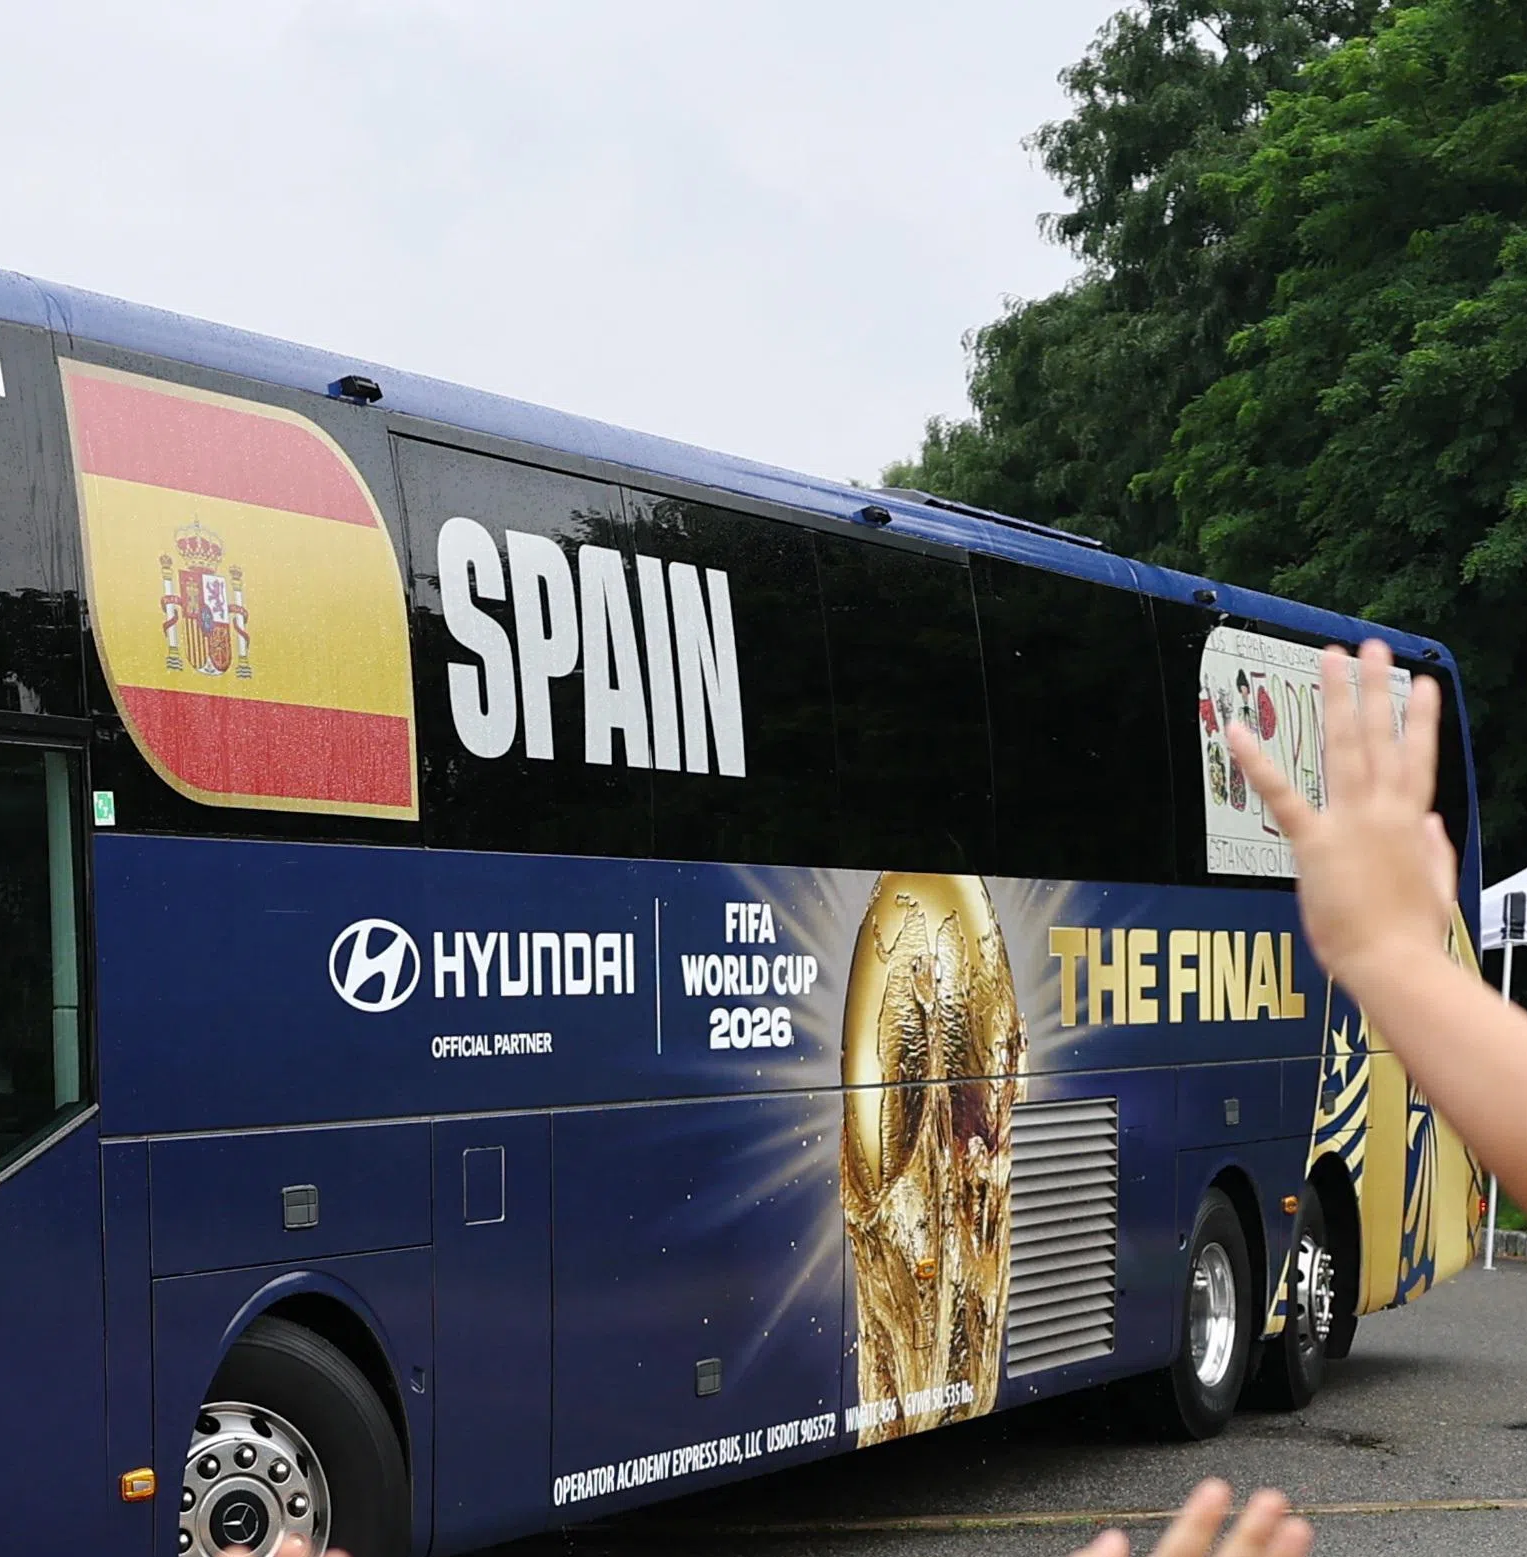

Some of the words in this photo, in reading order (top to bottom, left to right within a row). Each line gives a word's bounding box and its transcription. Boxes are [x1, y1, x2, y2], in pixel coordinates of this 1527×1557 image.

[437, 516, 746, 777] SPAIN
[725, 902, 776, 944] FIFA
[433, 932, 635, 998] HYUNDAI
[681, 955, 769, 997] WORLD
[772, 955, 818, 995] CUP
[1048, 926, 1159, 1027] THE
[1169, 930, 1305, 1024] FINAL
[431, 1033, 492, 1059] OFFICIAL
[494, 1032, 553, 1056] PARTNER
[709, 1006, 794, 1050] 2026
[553, 1465, 615, 1506] OPERATOR
[616, 1451, 671, 1491] ACADEMY
[672, 1440, 718, 1477] EXPRESS
[719, 1435, 743, 1464] BUS,
[744, 1429, 763, 1459] LLC
[767, 1419, 800, 1453] USDOT
[800, 1412, 836, 1444] 905572
